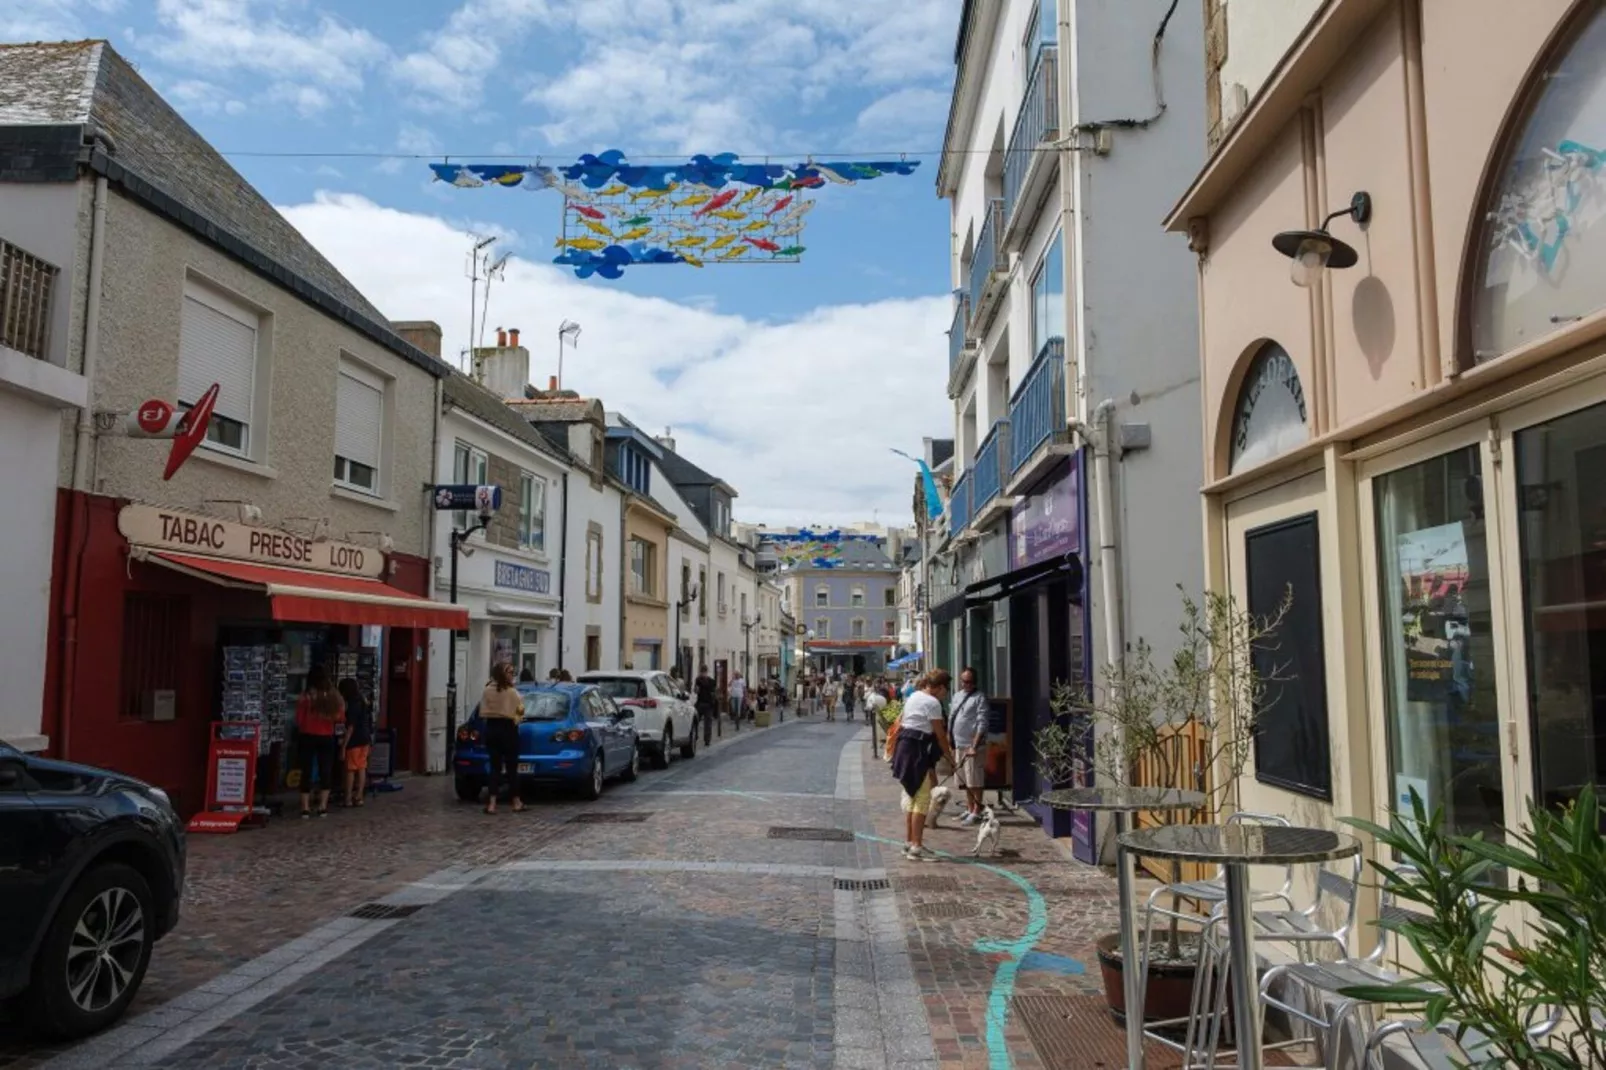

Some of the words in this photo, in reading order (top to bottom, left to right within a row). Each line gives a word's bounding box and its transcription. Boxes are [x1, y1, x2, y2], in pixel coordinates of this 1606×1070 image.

[158, 514, 225, 549] TABAC
[250, 531, 312, 562] PRESSE
[330, 545, 364, 570] LOTO
